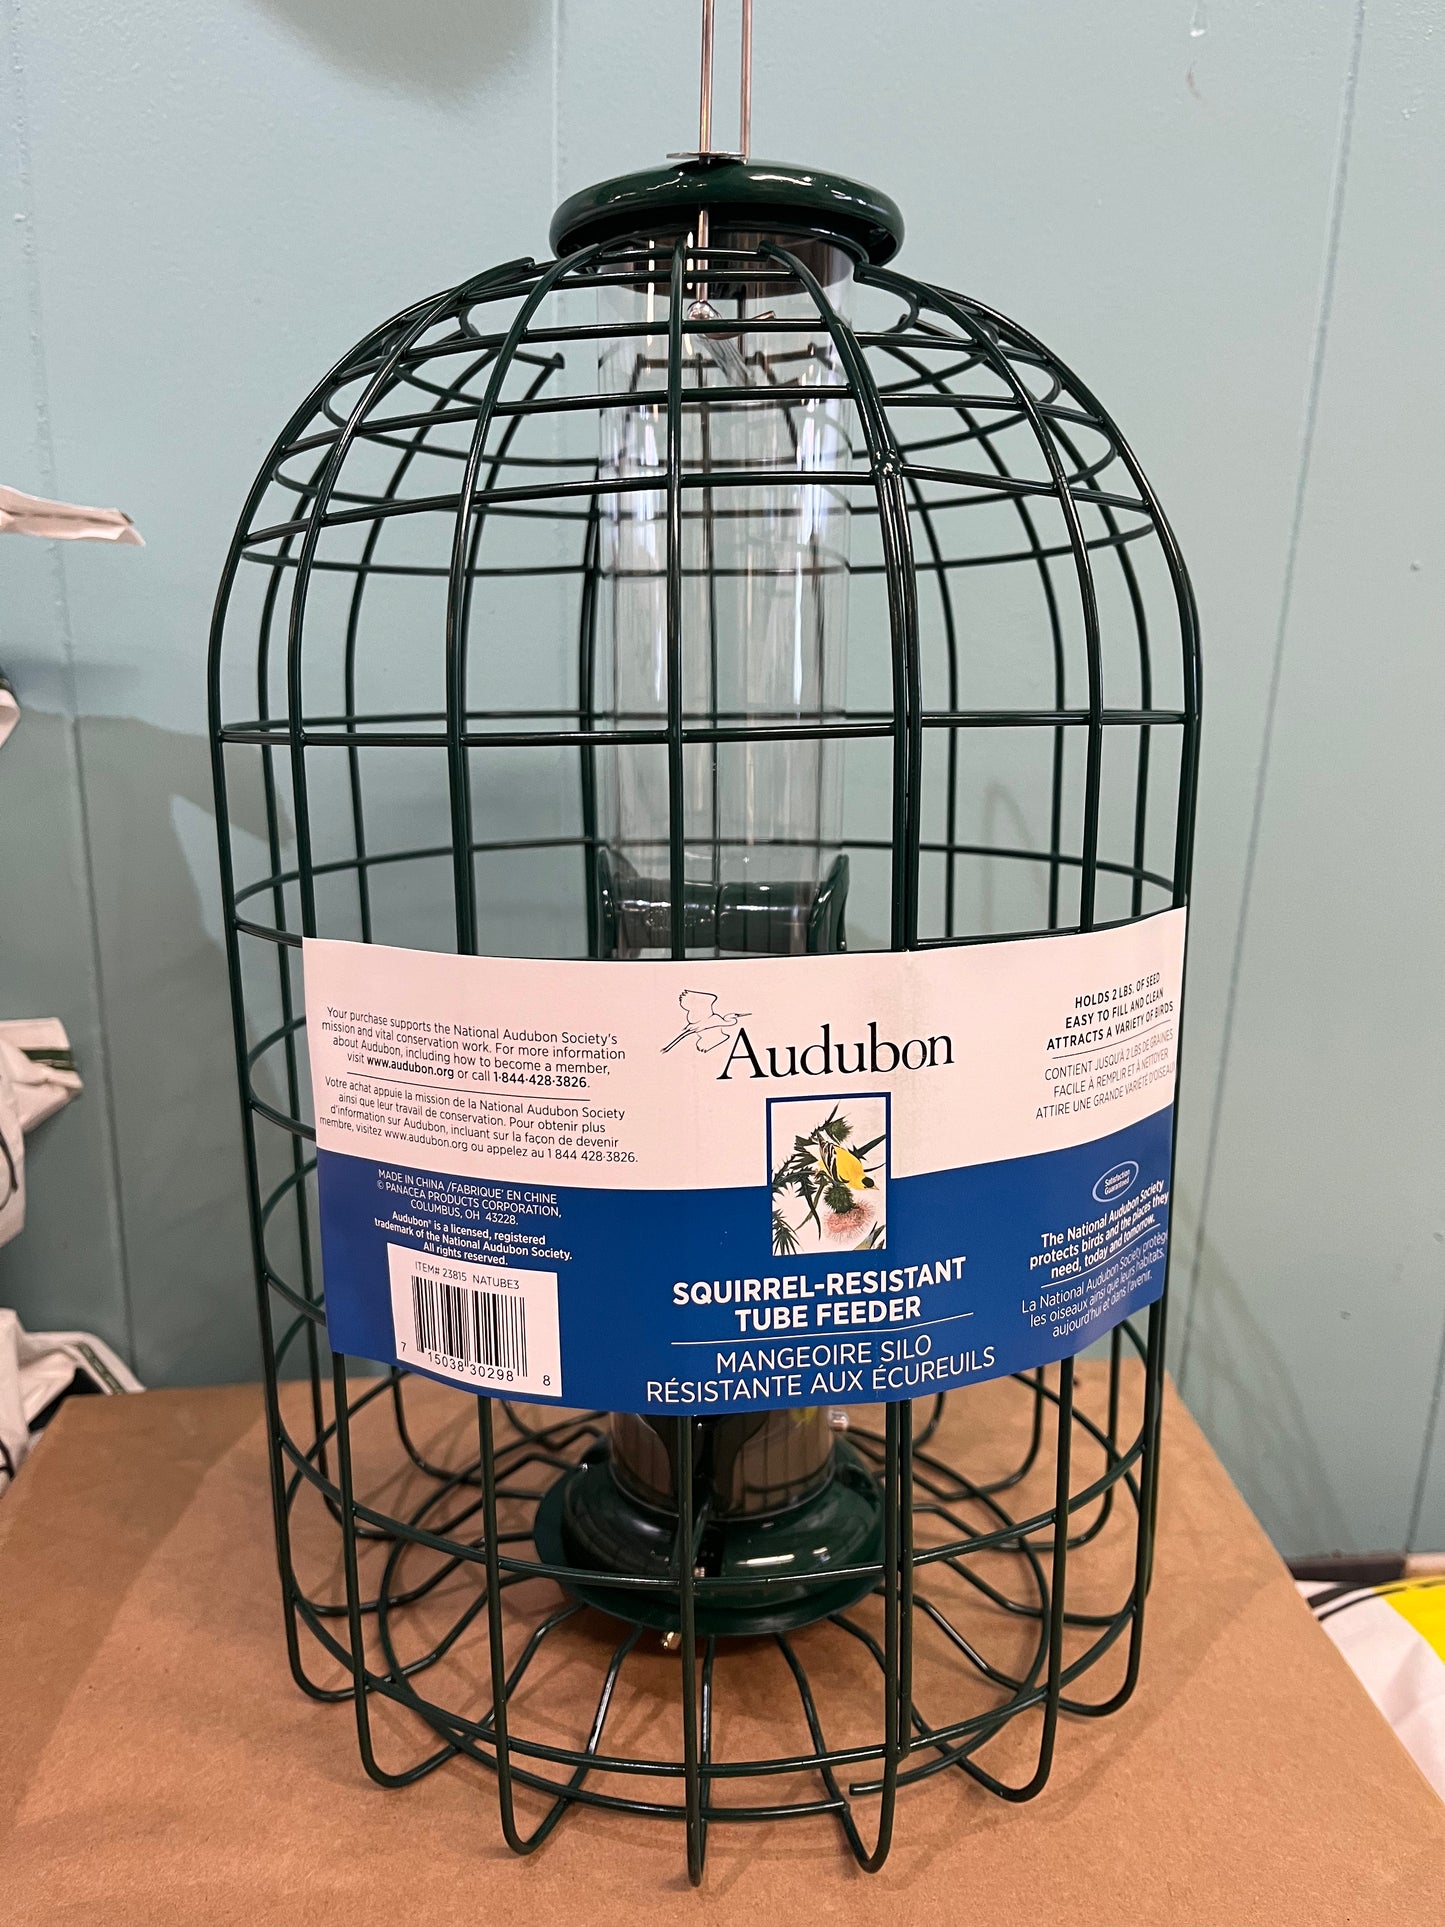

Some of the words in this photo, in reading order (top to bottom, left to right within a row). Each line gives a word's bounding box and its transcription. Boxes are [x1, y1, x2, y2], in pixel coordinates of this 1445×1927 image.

[1066, 1013, 1094, 1029] EASY
[1098, 1009, 1109, 1022] TO
[1113, 1004, 1128, 1018] FILL
[1130, 997, 1144, 1012] AND
[1146, 988, 1163, 1005] CLEAN
[1075, 991, 1109, 1008] HOLDS
[1112, 989, 1117, 1000] 2
[1119, 984, 1134, 998] LBS.
[1137, 979, 1145, 992] OF
[1146, 972, 1160, 988] SEED
[322, 1020, 355, 1034] mission
[358, 1027, 373, 1037] and
[375, 1028, 394, 1041] vital
[397, 1034, 459, 1050] conservation
[462, 1041, 491, 1053] work.
[496, 1043, 514, 1055] For
[519, 1047, 549, 1057] more
[553, 1046, 625, 1059] information
[327, 1007, 347, 1019] Your
[350, 1012, 388, 1026] purchase
[391, 1019, 431, 1032] supports
[434, 1023, 450, 1035] the
[454, 1025, 499, 1039] National
[503, 1029, 557, 1043] Audubon
[1047, 1029, 1103, 1050] ATTRACTS
[1106, 1027, 1112, 1038] A
[1115, 1015, 1144, 1035] VARIETY
[1146, 1009, 1153, 1022] OF
[1155, 1001, 1173, 1018] BIRDS
[333, 1035, 358, 1049] about
[361, 1040, 403, 1058] Audubon,
[406, 1047, 450, 1065] including
[454, 1053, 476, 1066] how
[480, 1057, 491, 1067] to
[495, 1057, 541, 1071] become
[545, 1063, 551, 1072] a
[556, 1062, 610, 1075] member,
[348, 1051, 364, 1064] visit
[367, 1057, 454, 1079] www.audubon.org
[458, 1070, 468, 1079] or
[472, 1070, 490, 1081] call
[716, 1021, 955, 1079] Audubon
[325, 1076, 347, 1089] Votre
[350, 1082, 371, 1093] achat
[374, 1087, 402, 1099] appuie
[405, 1090, 413, 1101] la
[415, 1093, 450, 1106] mission
[453, 1097, 465, 1108] de
[468, 1098, 477, 1109] la
[480, 1100, 523, 1113] National
[527, 1104, 578, 1117] Audubon
[582, 1107, 625, 1121] Society
[339, 1093, 357, 1104] ainsi
[360, 1098, 375, 1108] que
[377, 1099, 393, 1111] leur
[396, 1103, 423, 1116] travail
[425, 1107, 437, 1118] de
[440, 1111, 506, 1126] conservation.
[510, 1117, 534, 1129] Pour
[538, 1120, 578, 1131] obtenir
[582, 1122, 605, 1134] plus
[320, 1117, 354, 1132] membre,
[356, 1123, 382, 1136] visitez
[385, 1130, 468, 1152] www.audubon.org
[471, 1143, 484, 1152] ou
[487, 1145, 528, 1157] appelez
[531, 1150, 544, 1158] au
[548, 1148, 551, 1158] 1
[555, 1149, 577, 1160] 844
[388, 1117, 401, 1126] sur
[404, 1118, 448, 1135] Audubon,
[451, 1124, 490, 1139] incluant
[493, 1132, 509, 1140] sur
[513, 1131, 521, 1142] la
[525, 1132, 555, 1145] façon
[559, 1135, 572, 1146] de
[576, 1136, 619, 1147] devenir
[379, 1169, 403, 1183] MADE
[405, 1175, 414, 1185] IN
[416, 1177, 445, 1191] CHINA
[507, 1190, 521, 1201] EN
[524, 1192, 557, 1204] CHINE
[386, 1182, 426, 1199] PANACEA
[428, 1191, 479, 1208] PRODUCTS
[482, 1199, 561, 1218] CORPORATION,
[411, 1199, 463, 1219] COLUMBUS,
[465, 1209, 480, 1220] OH
[486, 1212, 518, 1225] 43228.
[1030, 1244, 1079, 1270] protects
[1082, 1233, 1104, 1253] birds
[1106, 1221, 1120, 1241] and
[1121, 1216, 1131, 1231] the
[1132, 1201, 1151, 1225] places
[1153, 1192, 1169, 1208] they
[1041, 1233, 1064, 1248] The
[1068, 1213, 1107, 1242] National
[1108, 1196, 1139, 1224] Audubon
[1140, 1180, 1164, 1203] Society
[375, 1218, 414, 1236] trademark
[416, 1229, 424, 1238] of
[426, 1231, 440, 1242] the
[442, 1234, 480, 1249] National
[483, 1241, 528, 1255] Audubon
[532, 1247, 572, 1261] Society.
[434, 1220, 441, 1231] is
[443, 1224, 448, 1232] a
[451, 1224, 492, 1241] licensed,
[495, 1232, 545, 1245] registered
[424, 1242, 434, 1252] All
[436, 1245, 462, 1259] rights
[464, 1252, 508, 1265] reserved.
[416, 1262, 440, 1275] ITEM#
[443, 1268, 467, 1282] 23815
[473, 1275, 519, 1290] NATUBE3
[672, 1256, 967, 1305] SQUIRREL-RESISTANT
[735, 1304, 809, 1332] TUBE
[816, 1296, 922, 1326] FEEDER
[401, 1342, 407, 1352] 7
[428, 1352, 464, 1372] 15038
[470, 1364, 514, 1382] 30298
[543, 1375, 551, 1386] 8
[716, 1341, 872, 1374] MANGEOIRE
[880, 1334, 932, 1362] SILO
[647, 1373, 803, 1404] RÉSISTANTE
[810, 1369, 864, 1394] AUX
[872, 1346, 996, 1390] ÉCUREUILS
